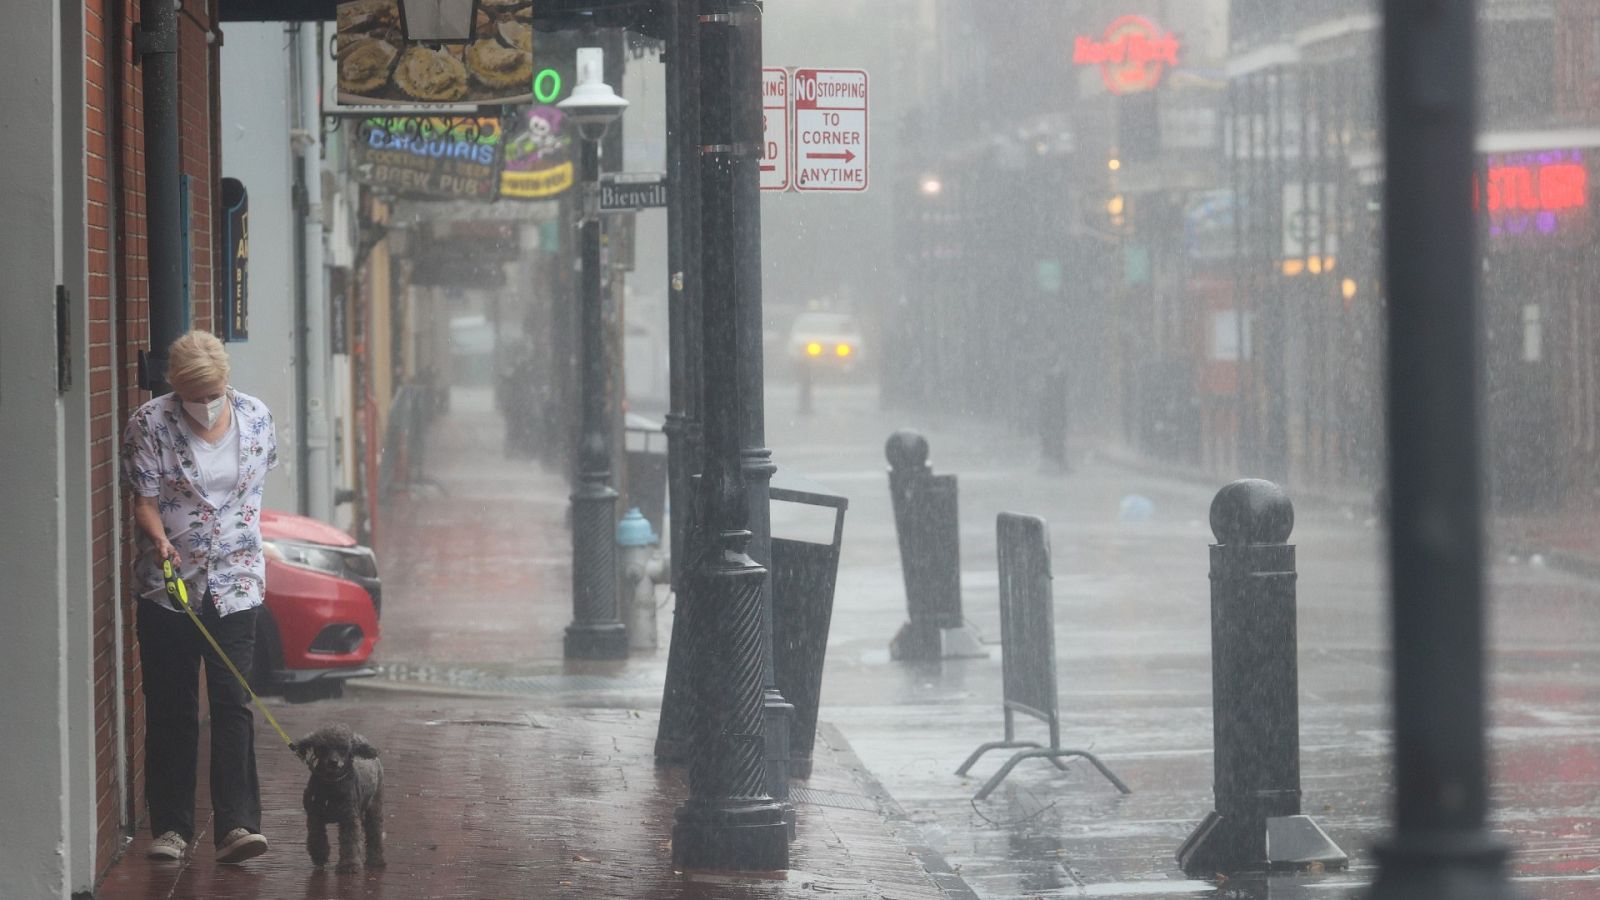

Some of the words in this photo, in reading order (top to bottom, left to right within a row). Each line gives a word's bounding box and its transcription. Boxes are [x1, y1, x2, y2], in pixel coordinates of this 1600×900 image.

[796, 78, 816, 102] NO
[817, 82, 865, 99] STOPPING
[822, 112, 840, 127] TO
[802, 131, 860, 145] CORNER
[375, 165, 431, 191] BREW
[440, 174, 478, 194] PUB
[801, 168, 863, 182] ANYTIME
[602, 185, 667, 208] Bienvill
